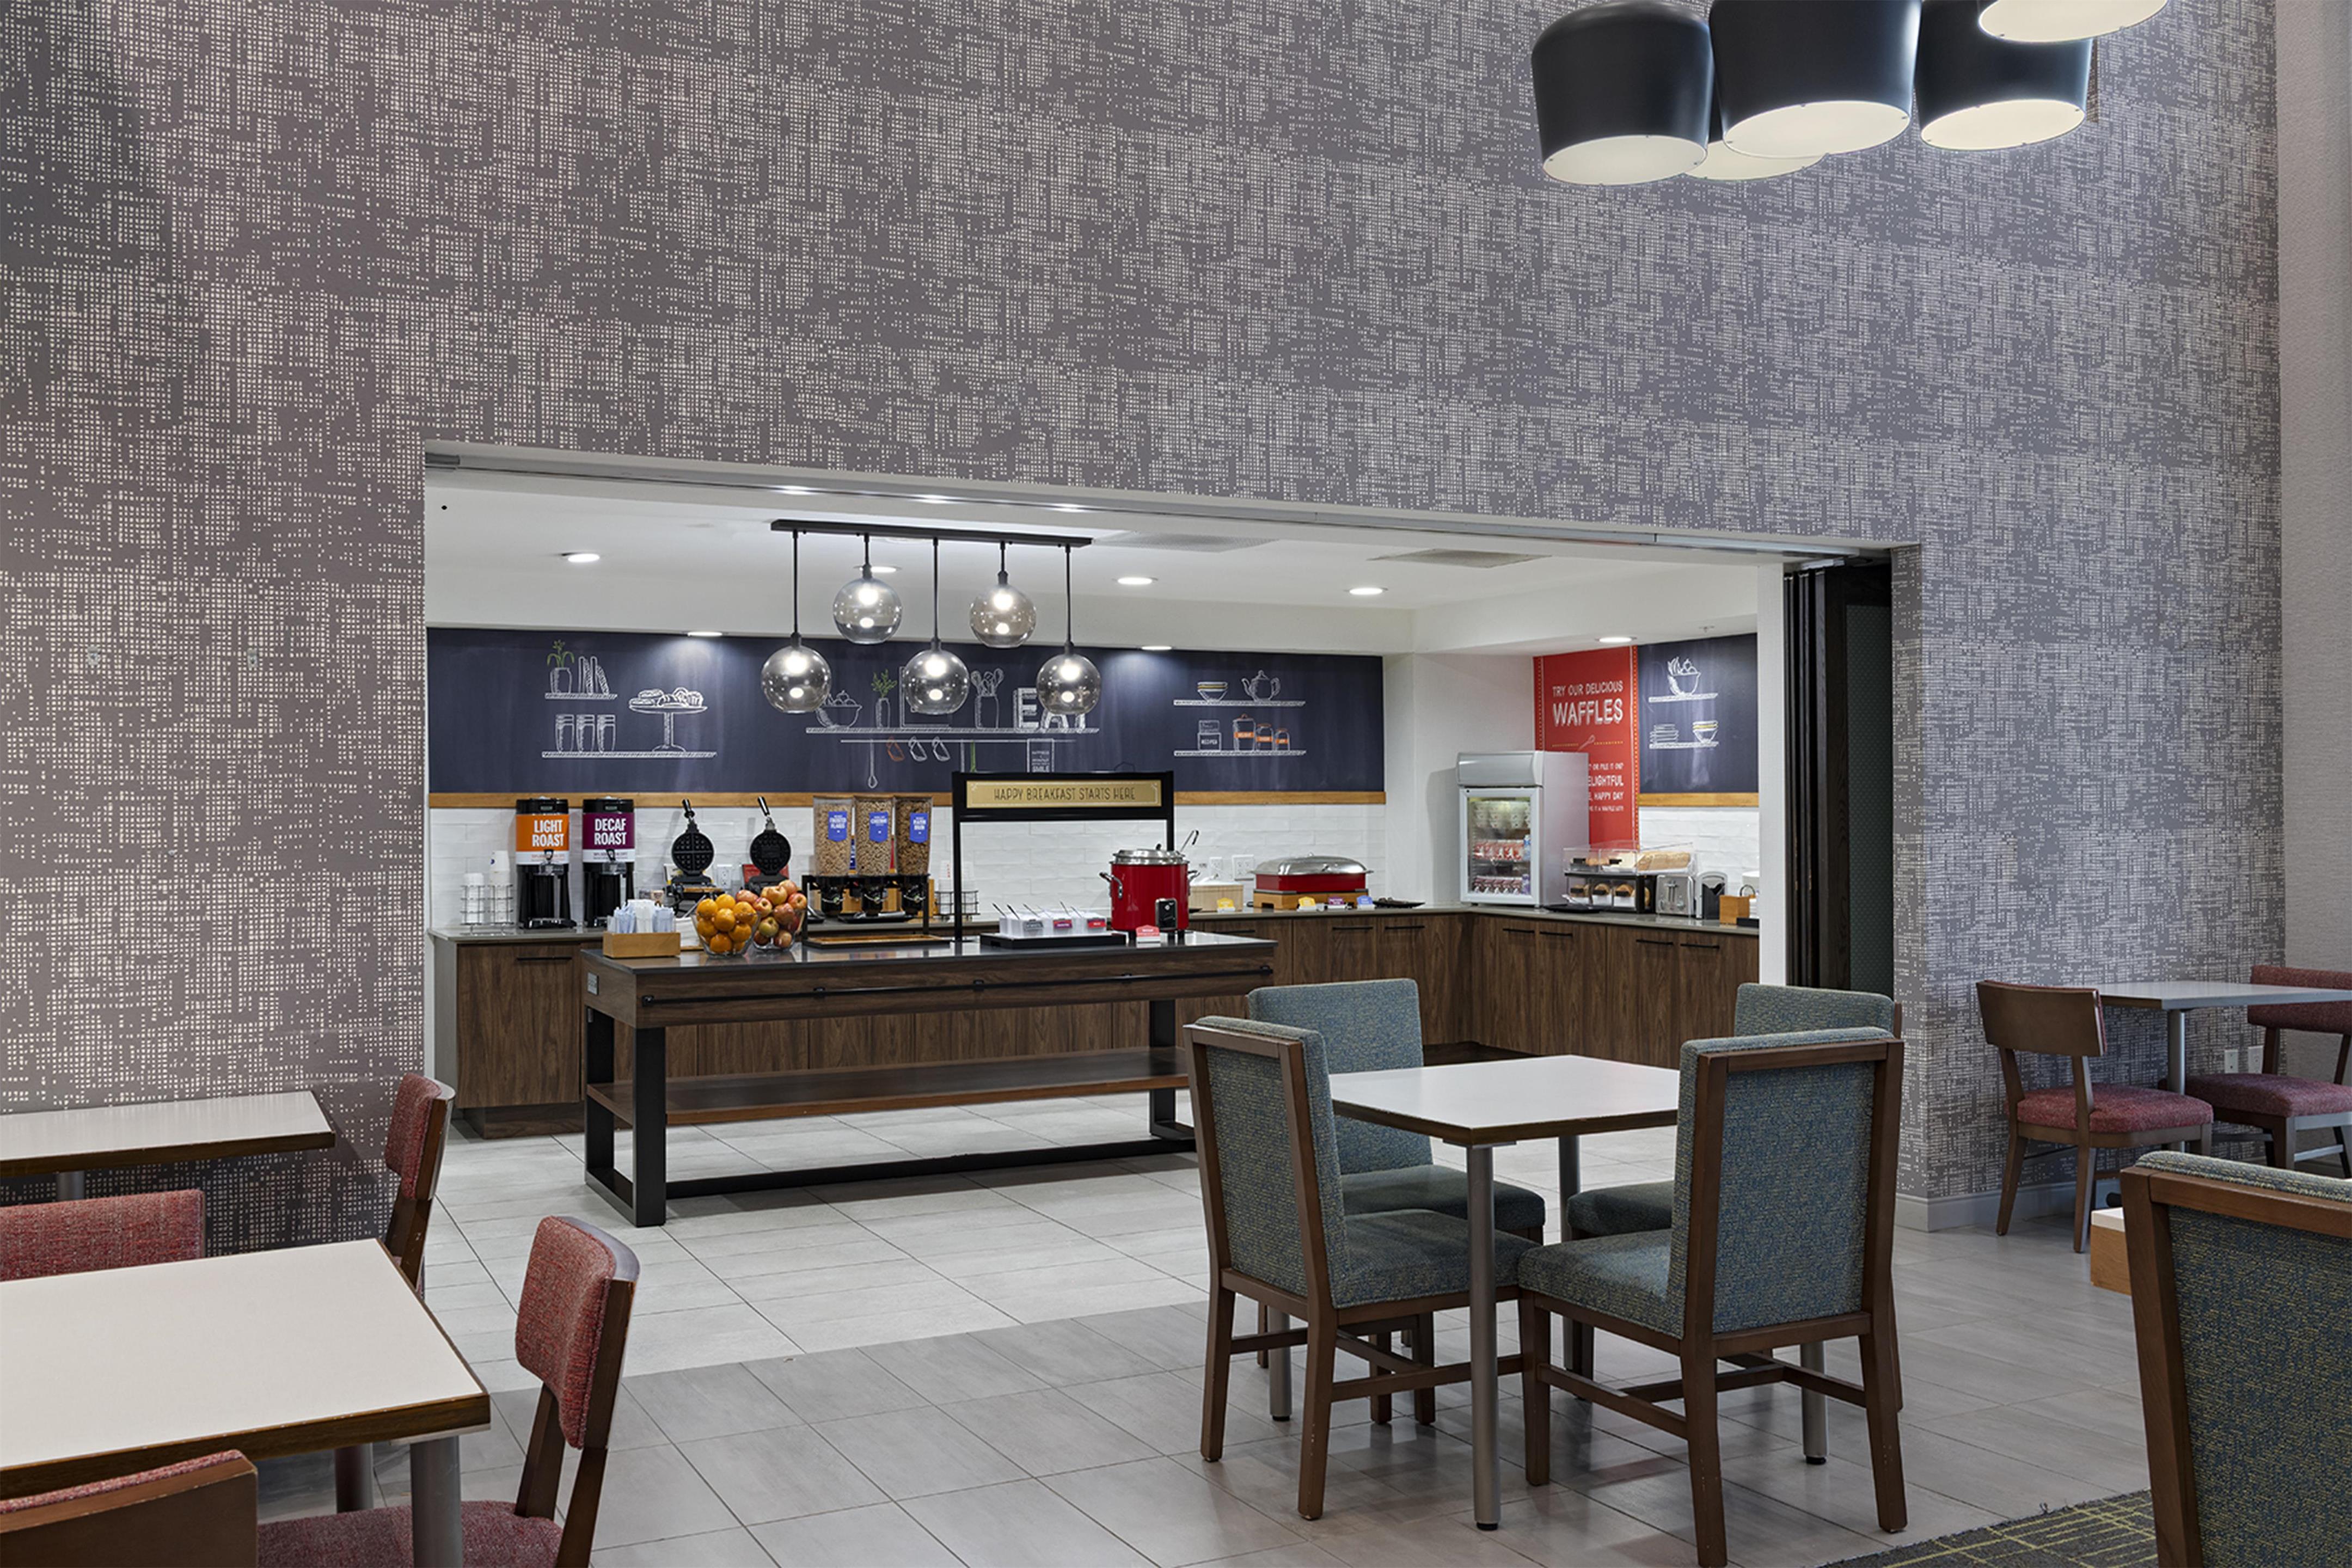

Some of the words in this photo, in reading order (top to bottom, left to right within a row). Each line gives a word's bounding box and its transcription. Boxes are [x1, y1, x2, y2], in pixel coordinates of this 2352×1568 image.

[1552, 686, 1566, 697] TRY
[1568, 684, 1584, 696] OUR
[1585, 680, 1624, 695] DELICIOUS
[1553, 697, 1624, 727] WAFFLES
[1588, 775, 1624, 787] ELIGHTFUL
[994, 788, 1023, 800] HAPPY
[1026, 787, 1076, 800] BREAKFAST
[1079, 787, 1110, 800] STARTS
[1113, 787, 1135, 800] HERE
[534, 819, 563, 834] LIGHT
[594, 818, 627, 831] DECAF
[532, 833, 565, 847] ROAST
[594, 832, 627, 846] ROAST
